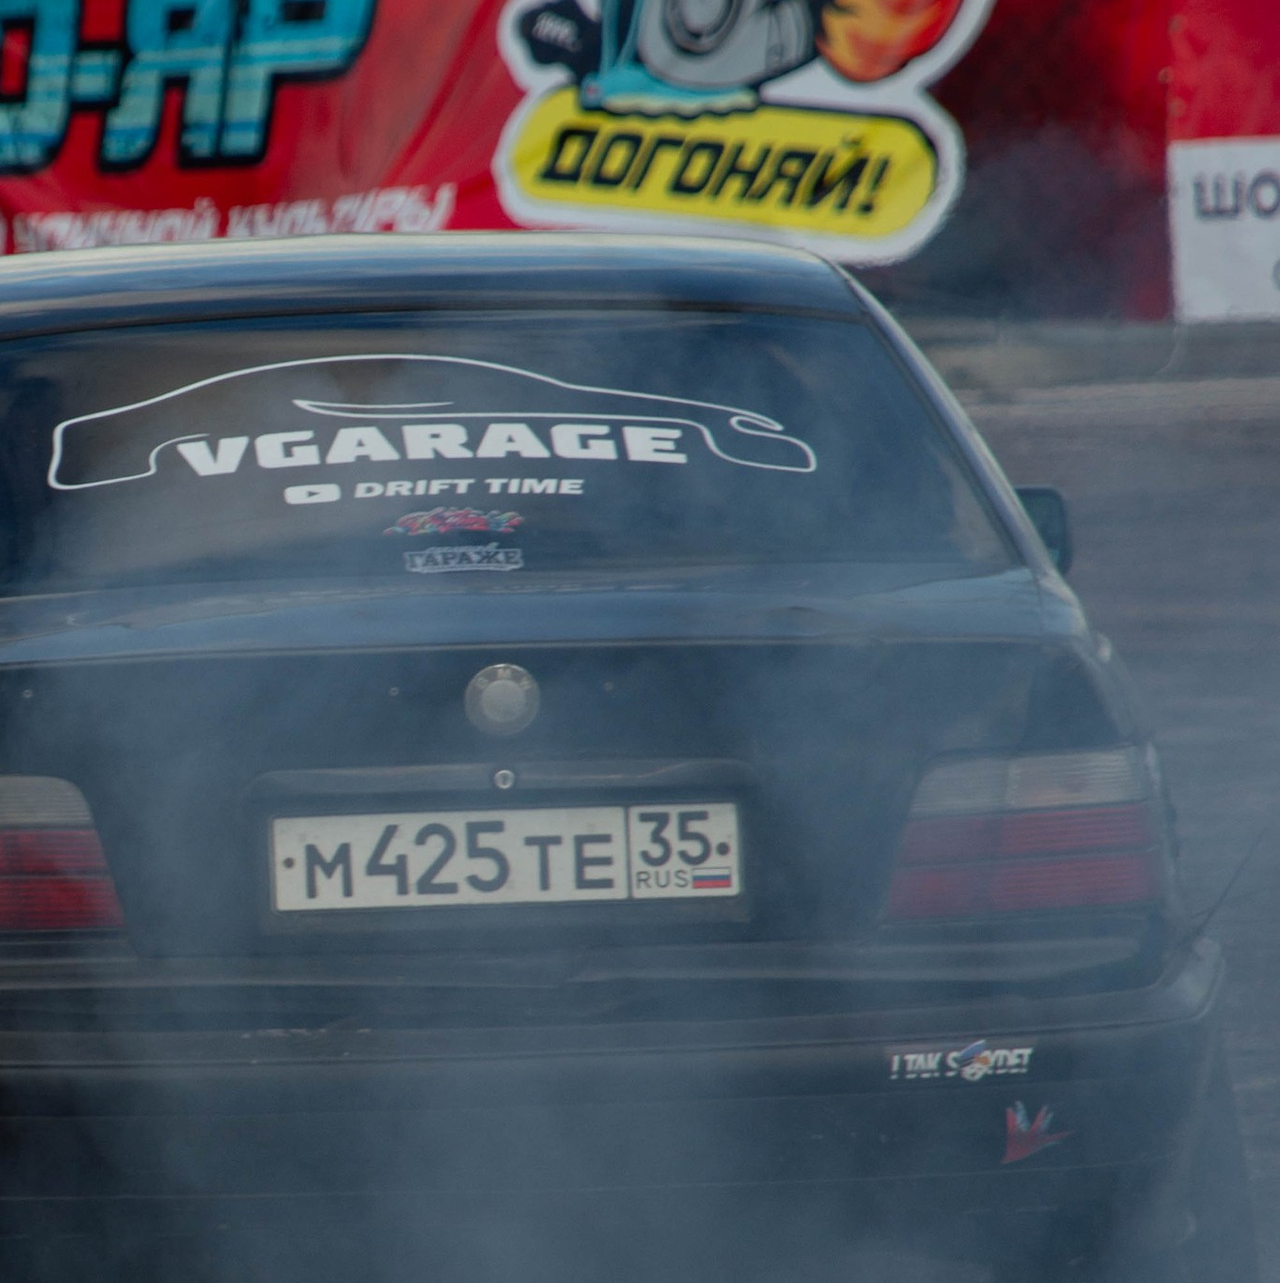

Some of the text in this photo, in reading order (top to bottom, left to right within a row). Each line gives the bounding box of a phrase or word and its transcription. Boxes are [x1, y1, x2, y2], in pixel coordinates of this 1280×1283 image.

[539, 127, 890, 213] ДОГОНЯЙ!
[177, 423, 688, 476] VGARAGE
[354, 478, 584, 498] DRIFT TIME
[638, 811, 712, 866] 35
[636, 870, 688, 890] RUS
